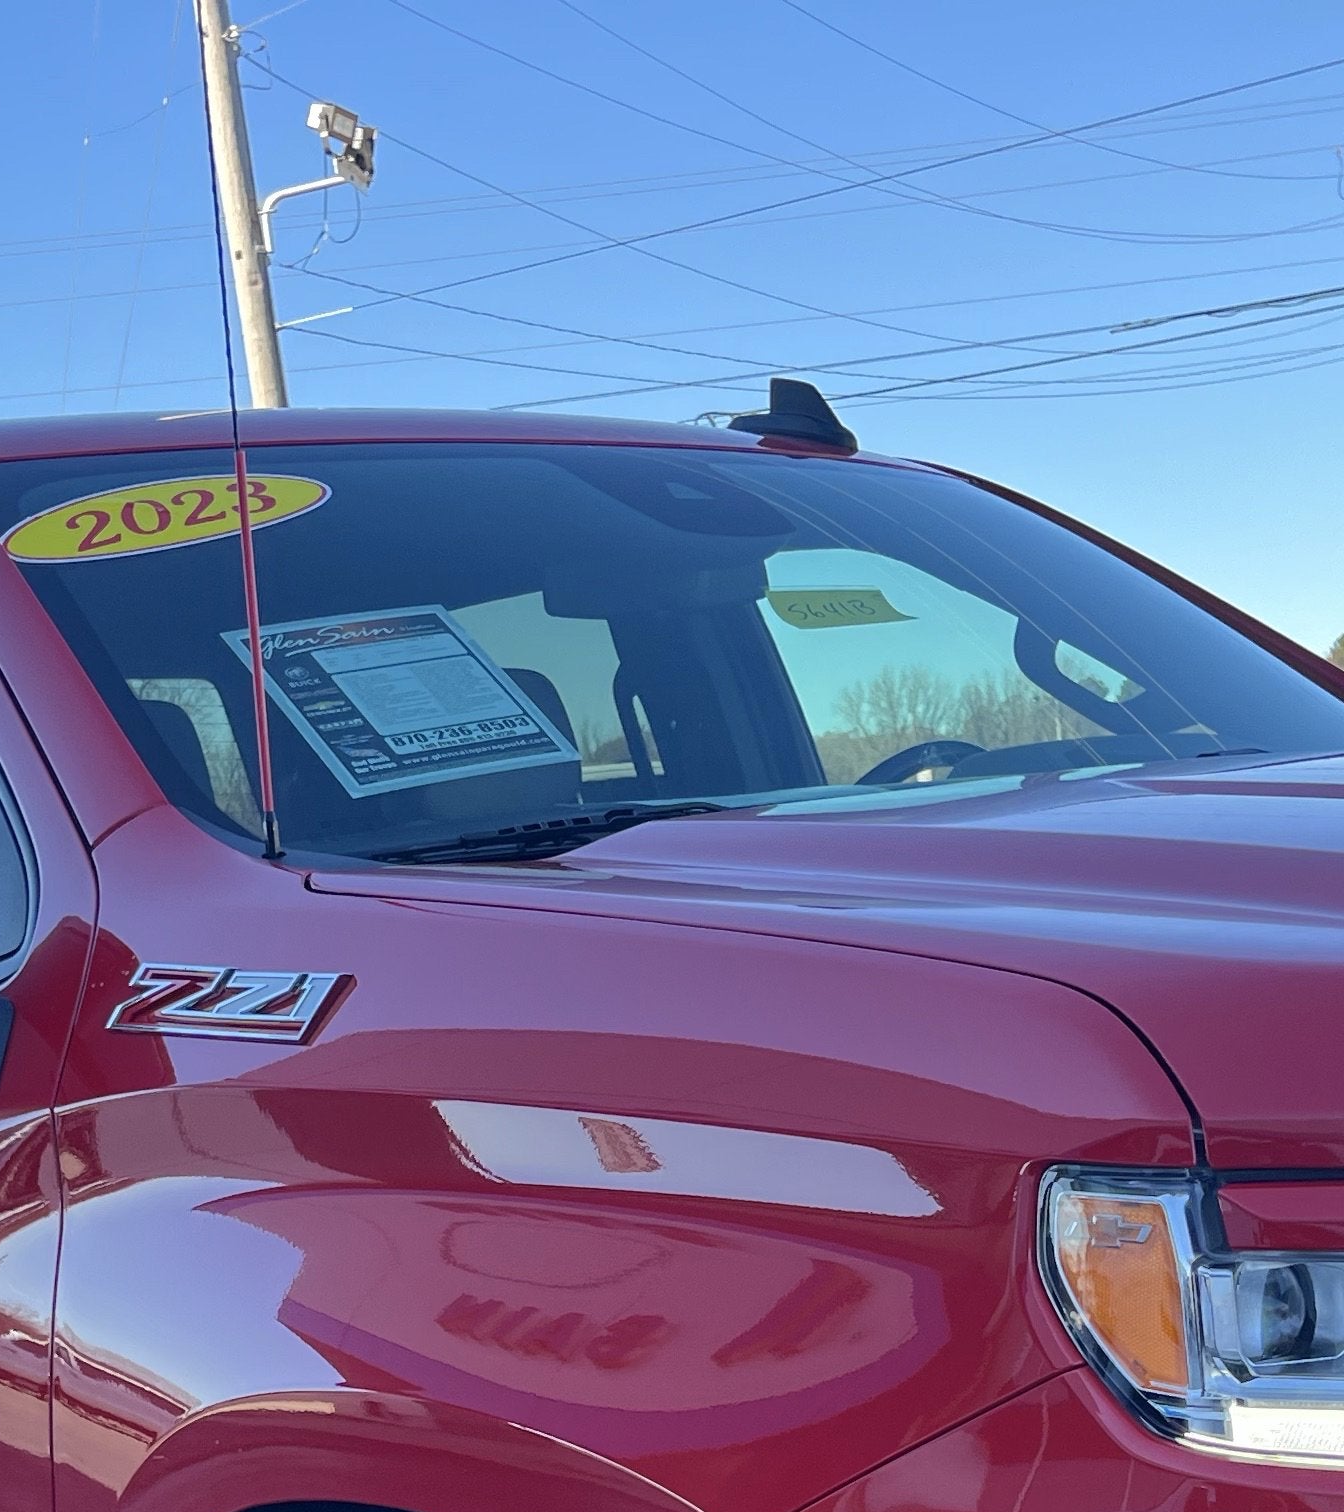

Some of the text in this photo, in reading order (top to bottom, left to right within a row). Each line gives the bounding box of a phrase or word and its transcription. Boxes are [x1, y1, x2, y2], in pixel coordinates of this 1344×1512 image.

[66, 480, 277, 552] 2023
[316, 626, 395, 645] Sain
[391, 715, 531, 748] 870-236-8503
[106, 962, 346, 1044] Z71
